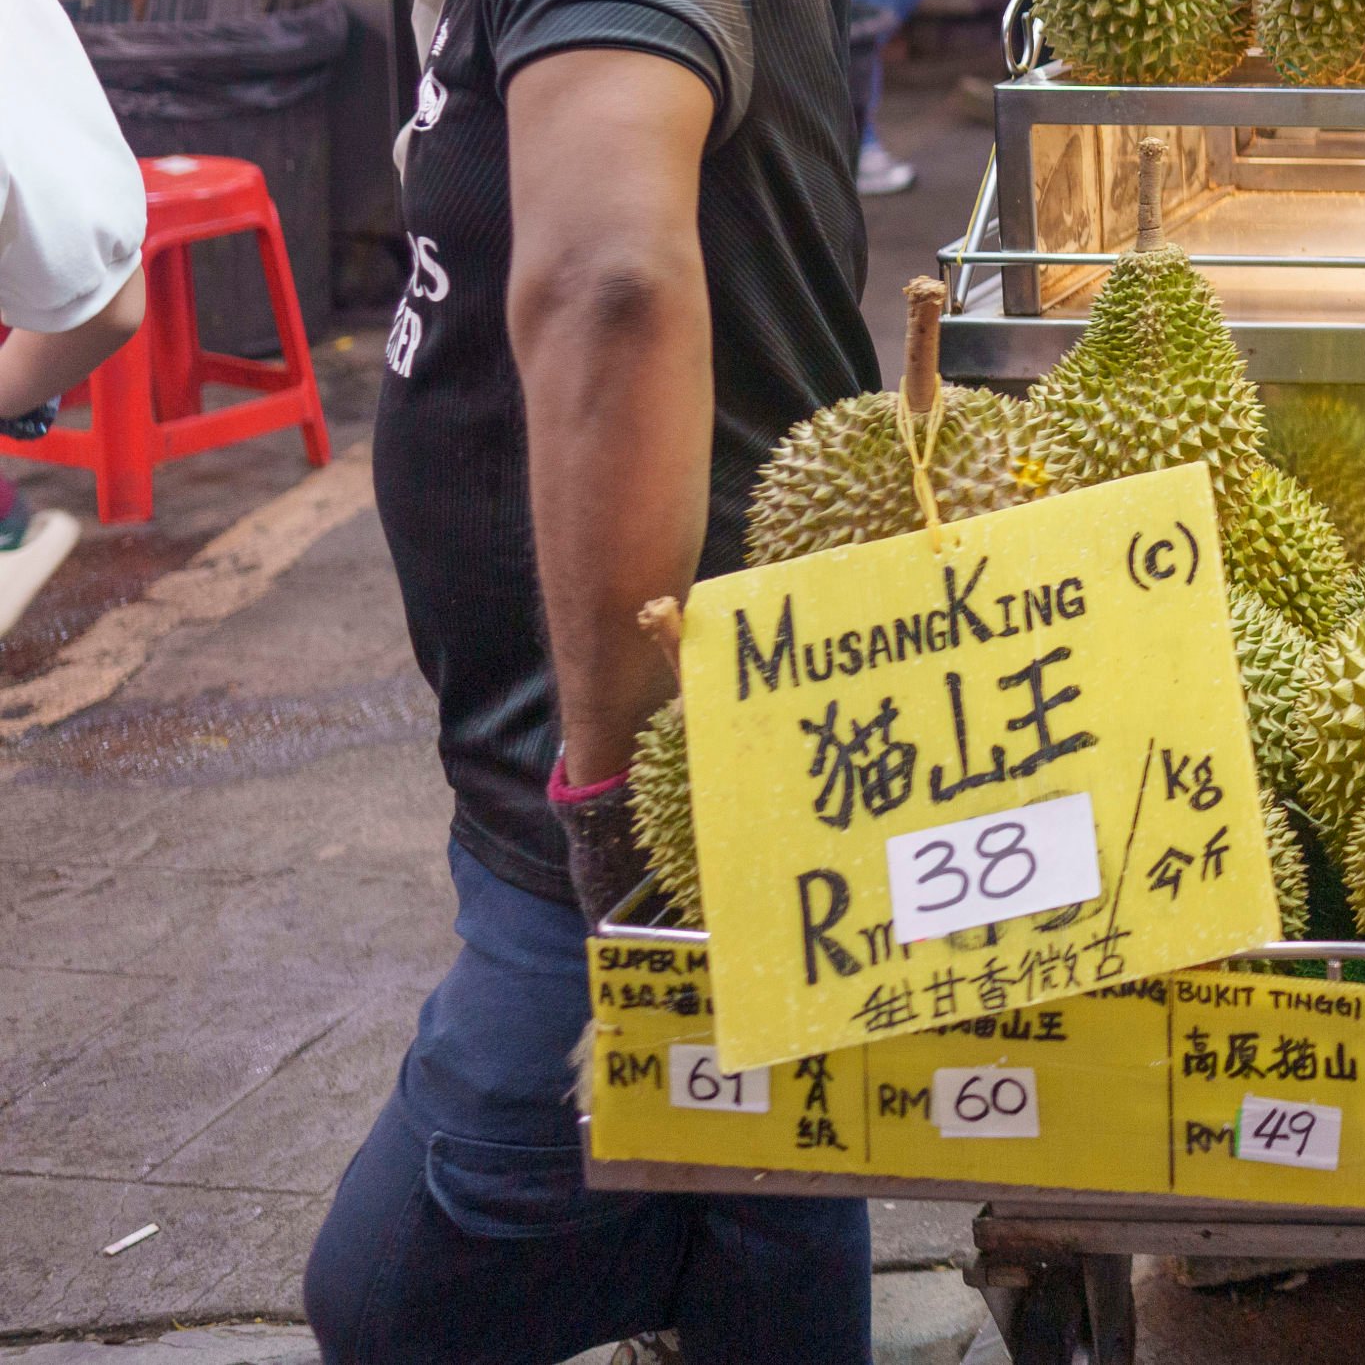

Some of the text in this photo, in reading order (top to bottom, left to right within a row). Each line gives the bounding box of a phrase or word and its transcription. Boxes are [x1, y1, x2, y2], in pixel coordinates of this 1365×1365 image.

[797, 645, 1100, 831] 猫山王
[911, 821, 1038, 914] 38
[1146, 825, 1231, 901] 公斤
[1176, 980, 1254, 1008] BUKIT
[1268, 988, 1362, 1020] TINGGI
[606, 1052, 663, 1090] RM
[878, 1075, 1029, 1123] RM 60
[1185, 1106, 1318, 1159] RM 49
